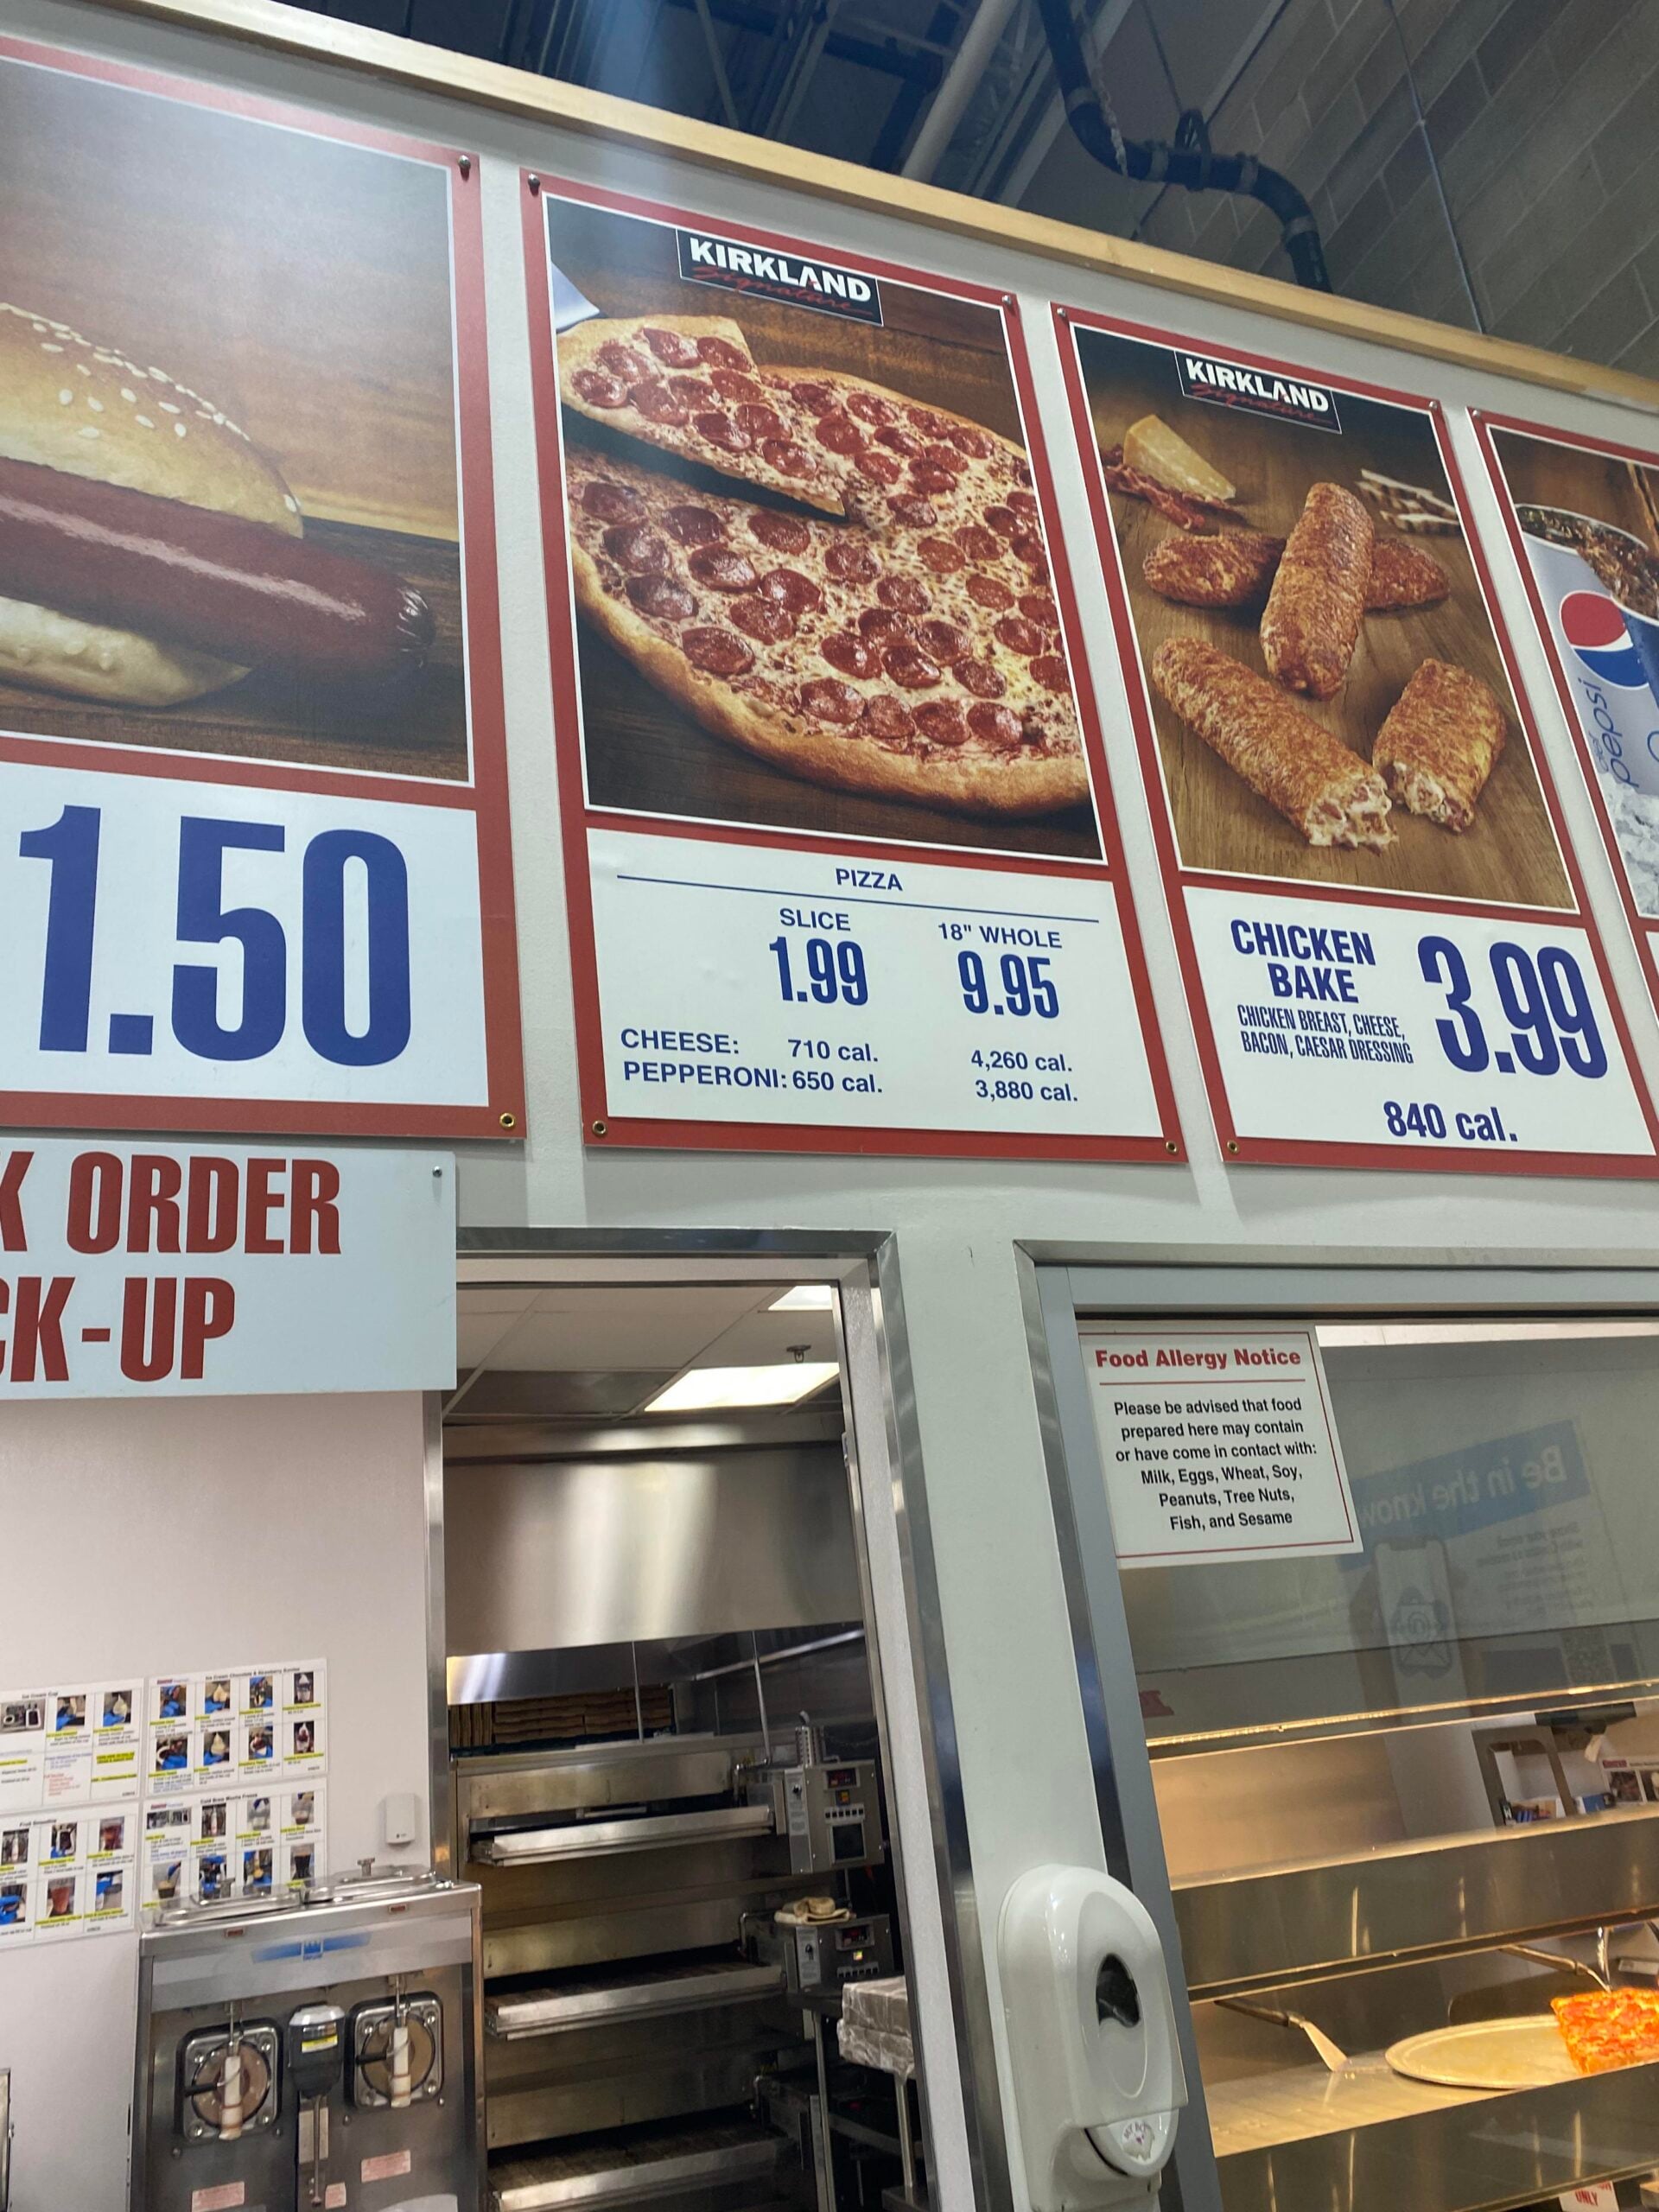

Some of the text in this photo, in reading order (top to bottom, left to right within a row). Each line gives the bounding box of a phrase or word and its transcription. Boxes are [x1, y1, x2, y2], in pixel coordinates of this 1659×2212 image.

[690, 237, 872, 302] KIRKLAND
[1185, 358, 1329, 412] KIRKLAND
[1578, 677, 1639, 788] pepsi
[835, 868, 904, 892] PIZZA
[18, 804, 411, 1067] 1.50
[779, 907, 852, 931] SLICE
[938, 922, 1063, 949] 18" WHOLE
[1230, 919, 1376, 966] CHICKEN
[769, 936, 868, 1007] 1.99
[957, 950, 1060, 1020] 9.95
[1267, 963, 1359, 1004] BAKE
[1237, 1004, 1406, 1040] CHICKEN BREAST, CHEESE,
[1417, 935, 1608, 1079] 3.99
[620, 1028, 879, 1063] CHEESE: 710 cal.
[971, 1049, 1073, 1072] 4,260 cal.
[1241, 1030, 1414, 1065] BACON, CAESAR DRESSING
[623, 1061, 883, 1094] PEPPERONI: 650 cal.
[975, 1079, 1078, 1103] 3,880 cal.
[1383, 1101, 1518, 1142] 840 cal.
[67, 1151, 341, 1255] ORDER
[0, 1277, 236, 1382] K-UP
[1095, 1348, 1301, 1370] Food Allergy Notice
[1114, 1397, 1302, 1416] Please be advised that food
[1121, 1420, 1304, 1442] prepared here may contain
[1116, 1441, 1317, 1462] or have come in contact with:
[1141, 1465, 1303, 1486] Milk, Eggs, Wheat, Soy,
[1159, 1487, 1294, 1507] Peanuts, Tree Nuts,
[1169, 1510, 1293, 1532] Fish, and Sesame
